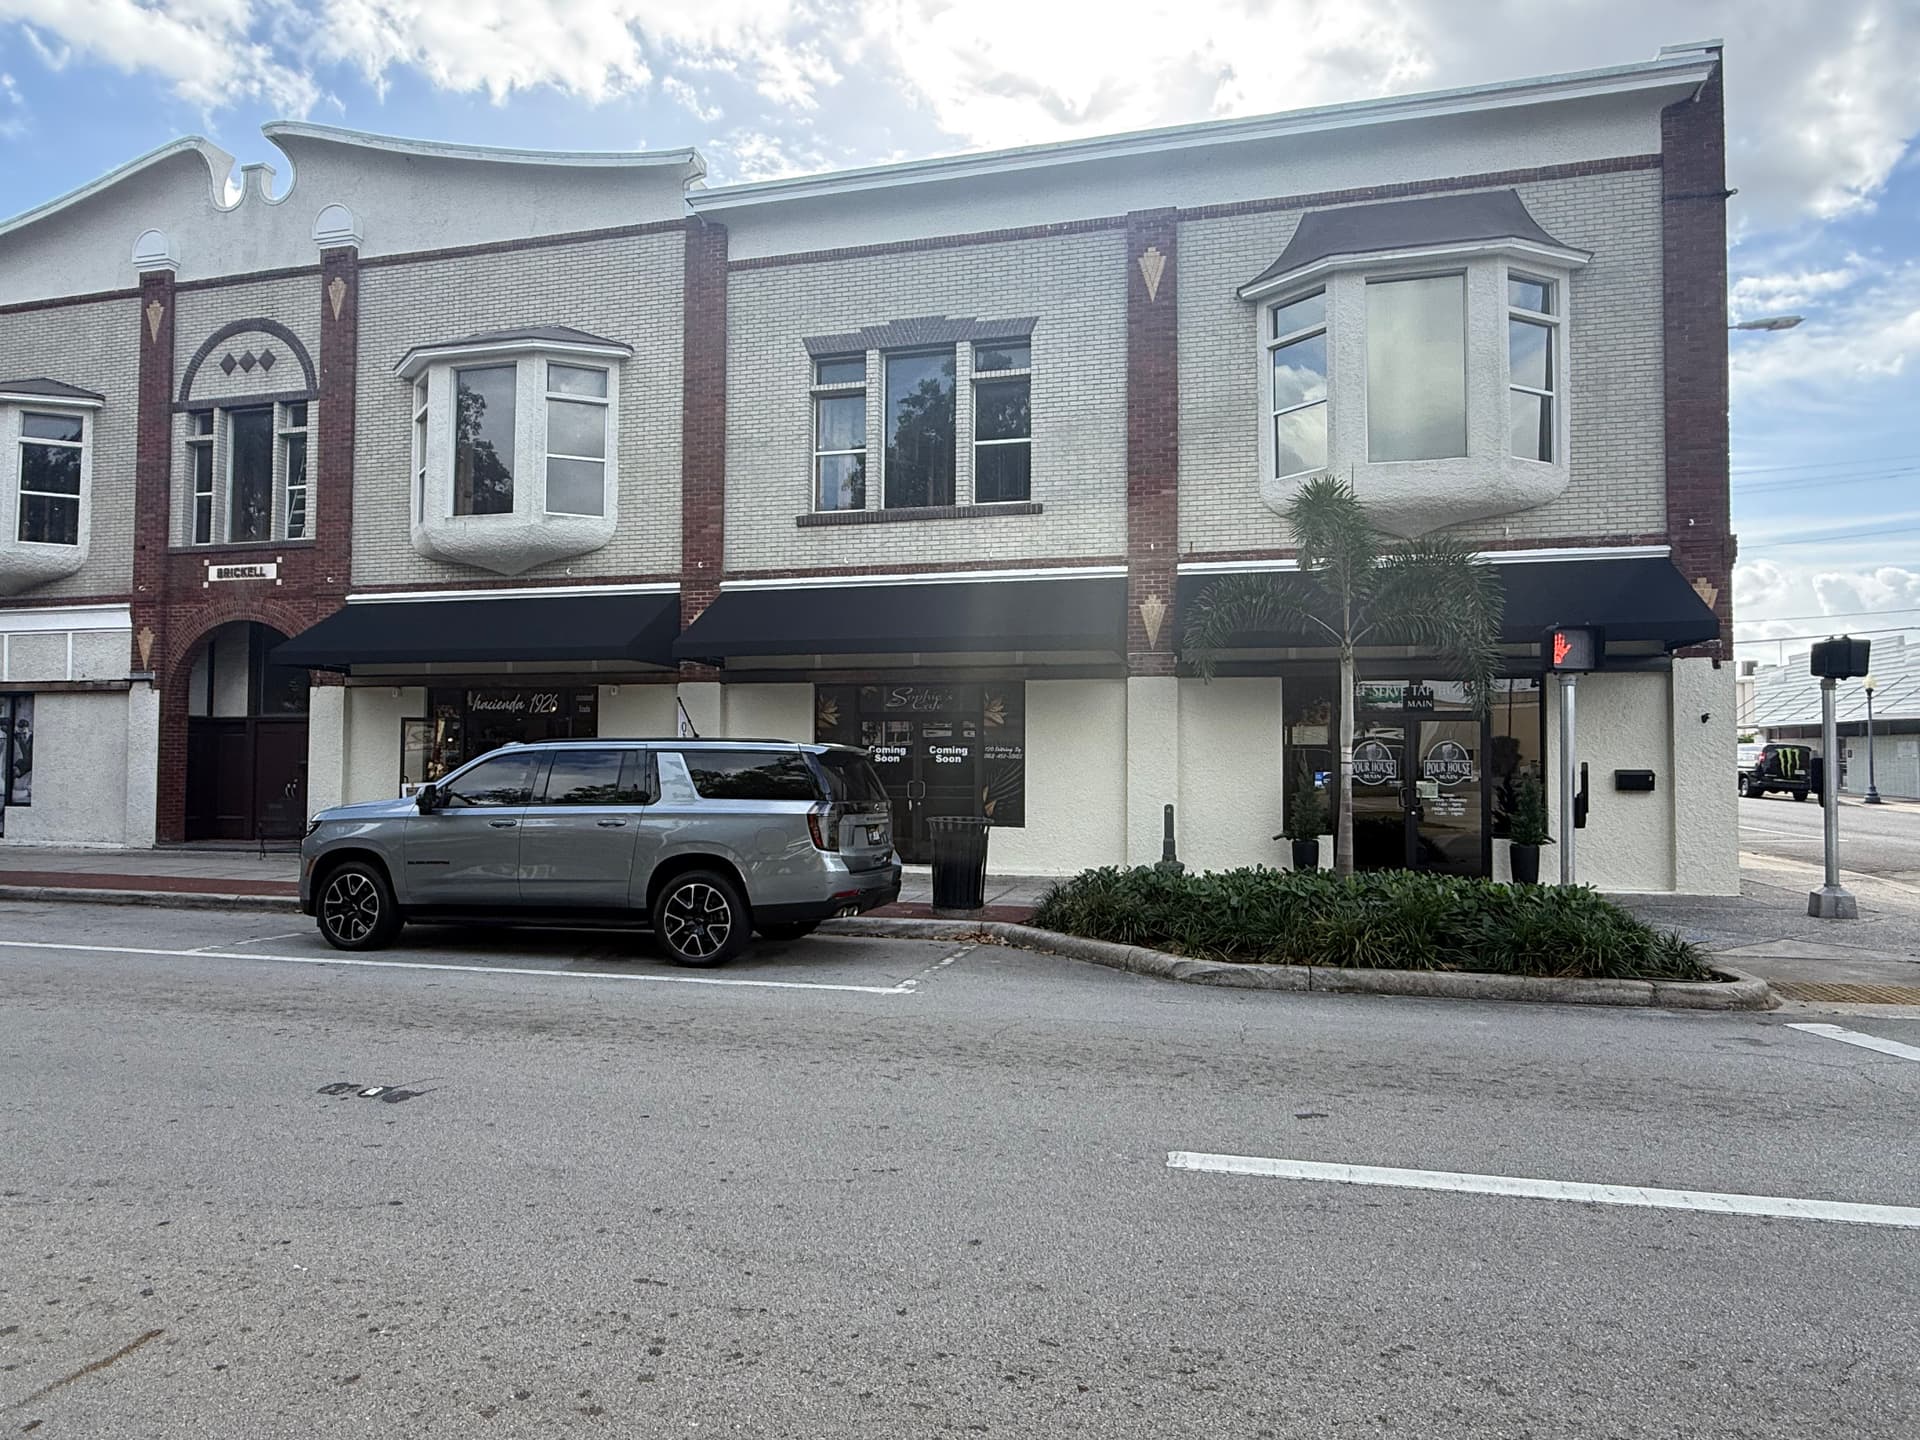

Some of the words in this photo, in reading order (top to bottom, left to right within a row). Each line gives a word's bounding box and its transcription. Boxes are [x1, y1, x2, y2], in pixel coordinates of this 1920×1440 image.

[216, 566, 266, 579] BRICKELL
[1372, 685, 1408, 698] SERVE
[1410, 684, 1433, 697] TAP
[529, 693, 558, 713] 1926
[1407, 699, 1433, 708] MAIN
[868, 745, 907, 756] Coming
[929, 745, 968, 757] Coming
[874, 754, 900, 763] Soon
[935, 754, 962, 763] Soon
[1371, 762, 1394, 776] HOUSE
[1426, 762, 1446, 775] POUR
[1447, 762, 1470, 776] HOUSE
